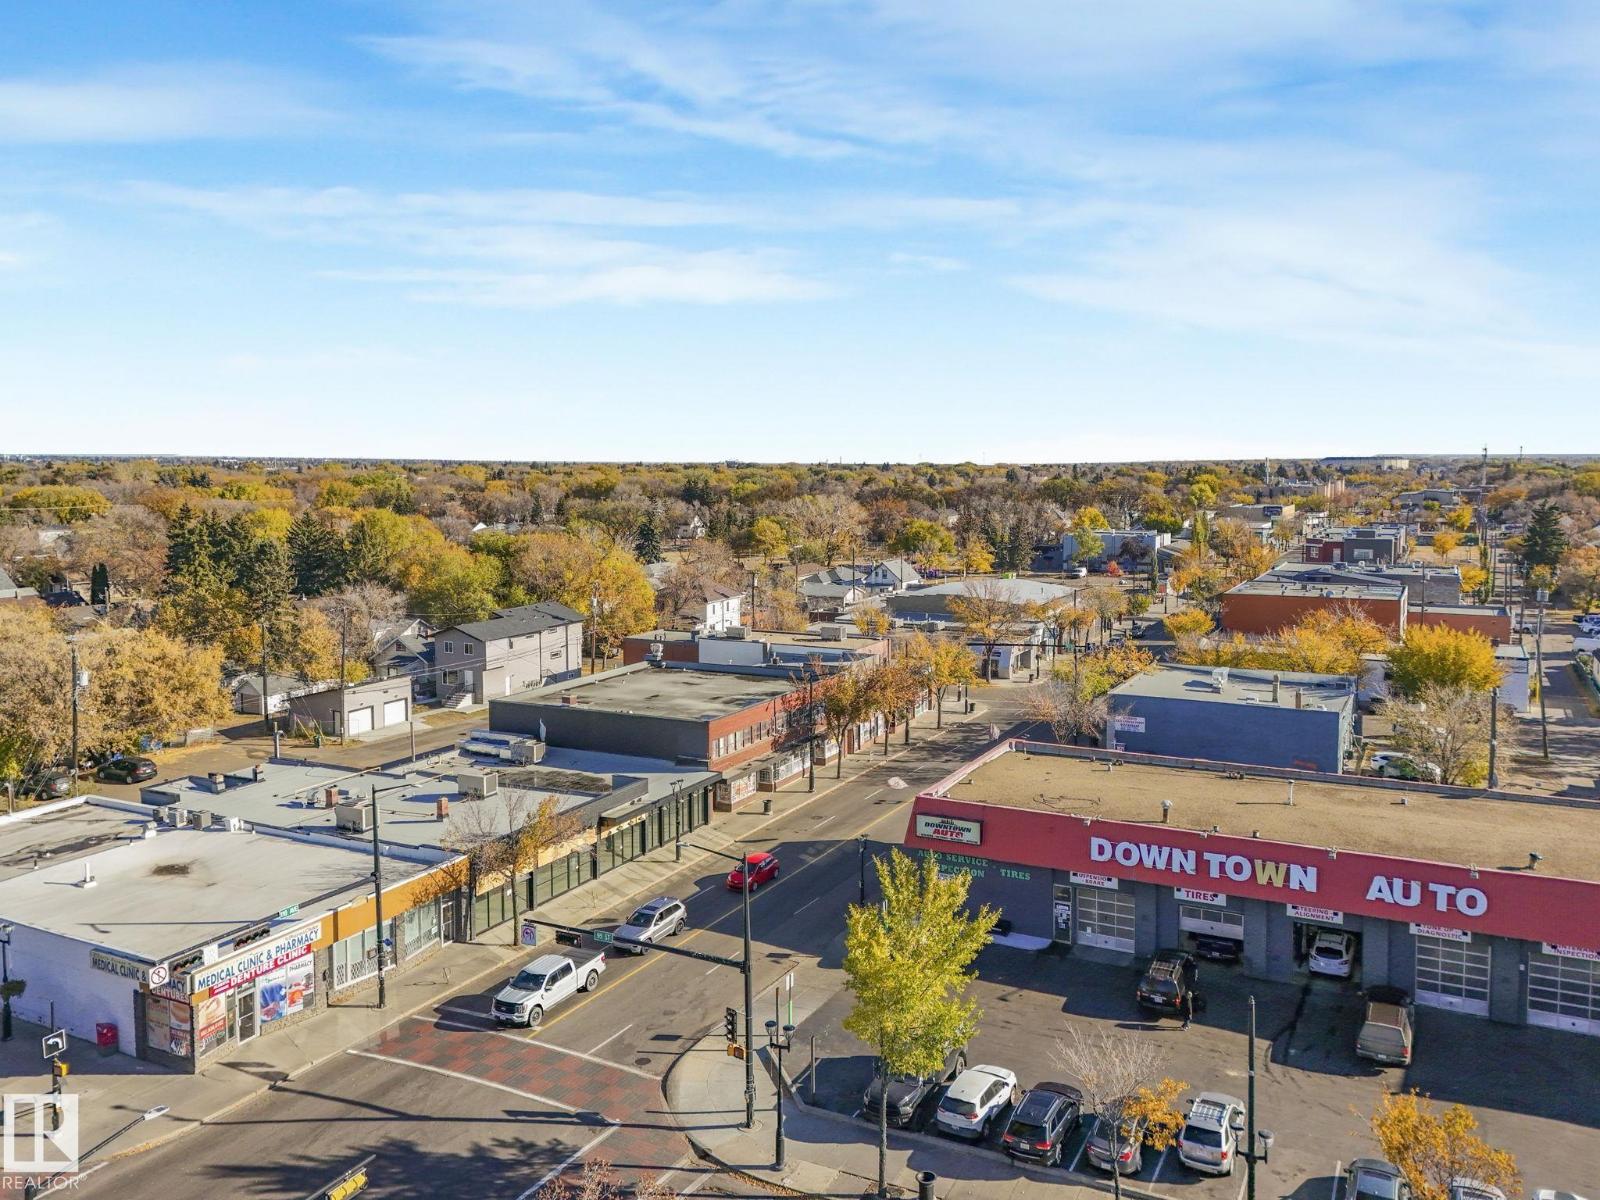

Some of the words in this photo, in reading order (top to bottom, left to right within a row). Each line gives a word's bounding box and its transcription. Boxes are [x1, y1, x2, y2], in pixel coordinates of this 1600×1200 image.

[924, 822, 972, 832] DOWNTOWN
[933, 828, 964, 838] AUTO
[946, 854, 989, 867] SERVICE
[1000, 869, 1031, 880] TIRES
[1185, 889, 1215, 902] TIRES
[1294, 911, 1335, 921] ALIGNMENT
[1417, 928, 1463, 940] DIAGNOSTIC
[197, 967, 236, 990] MEDICAL
[237, 952, 264, 973] CLINIC
[266, 949, 273, 961] &
[275, 928, 320, 955] PHARMACY
[92, 957, 119, 976] MEDICAL
[120, 964, 140, 980] CLINIC
[230, 959, 275, 986] DENTURE
[277, 945, 308, 965] CLINIC
[289, 960, 313, 972] PHARMACY
[151, 986, 189, 1001] DENTURES
